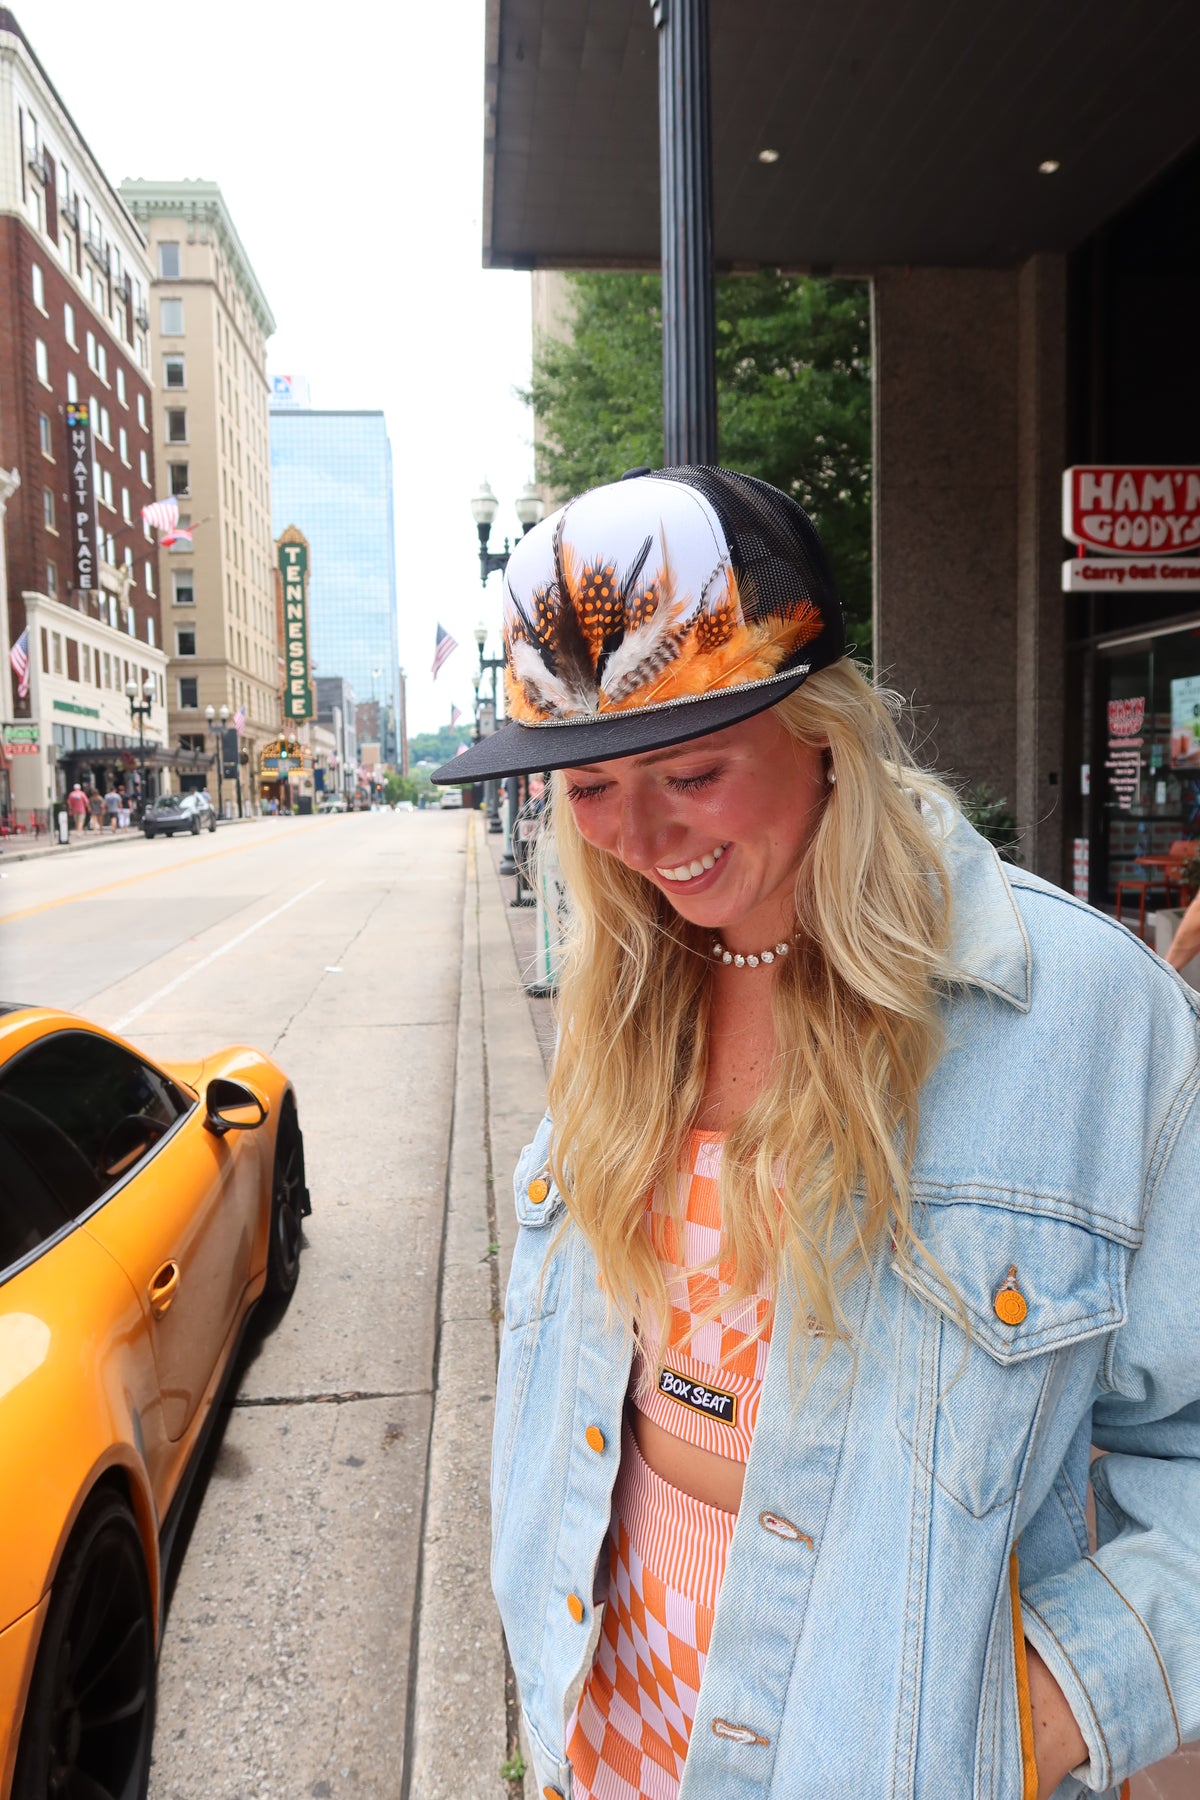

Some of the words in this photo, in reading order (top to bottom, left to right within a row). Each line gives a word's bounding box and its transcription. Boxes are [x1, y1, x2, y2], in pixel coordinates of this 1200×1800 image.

[72, 430, 89, 506] HYATT
[76, 511, 92, 589] PLACE
[1082, 564, 1126, 583] Carry
[1128, 563, 1157, 580] Out
[285, 547, 306, 715] TENNESSEE
[661, 1372, 691, 1398] BOX
[691, 1387, 731, 1413] SEAT
